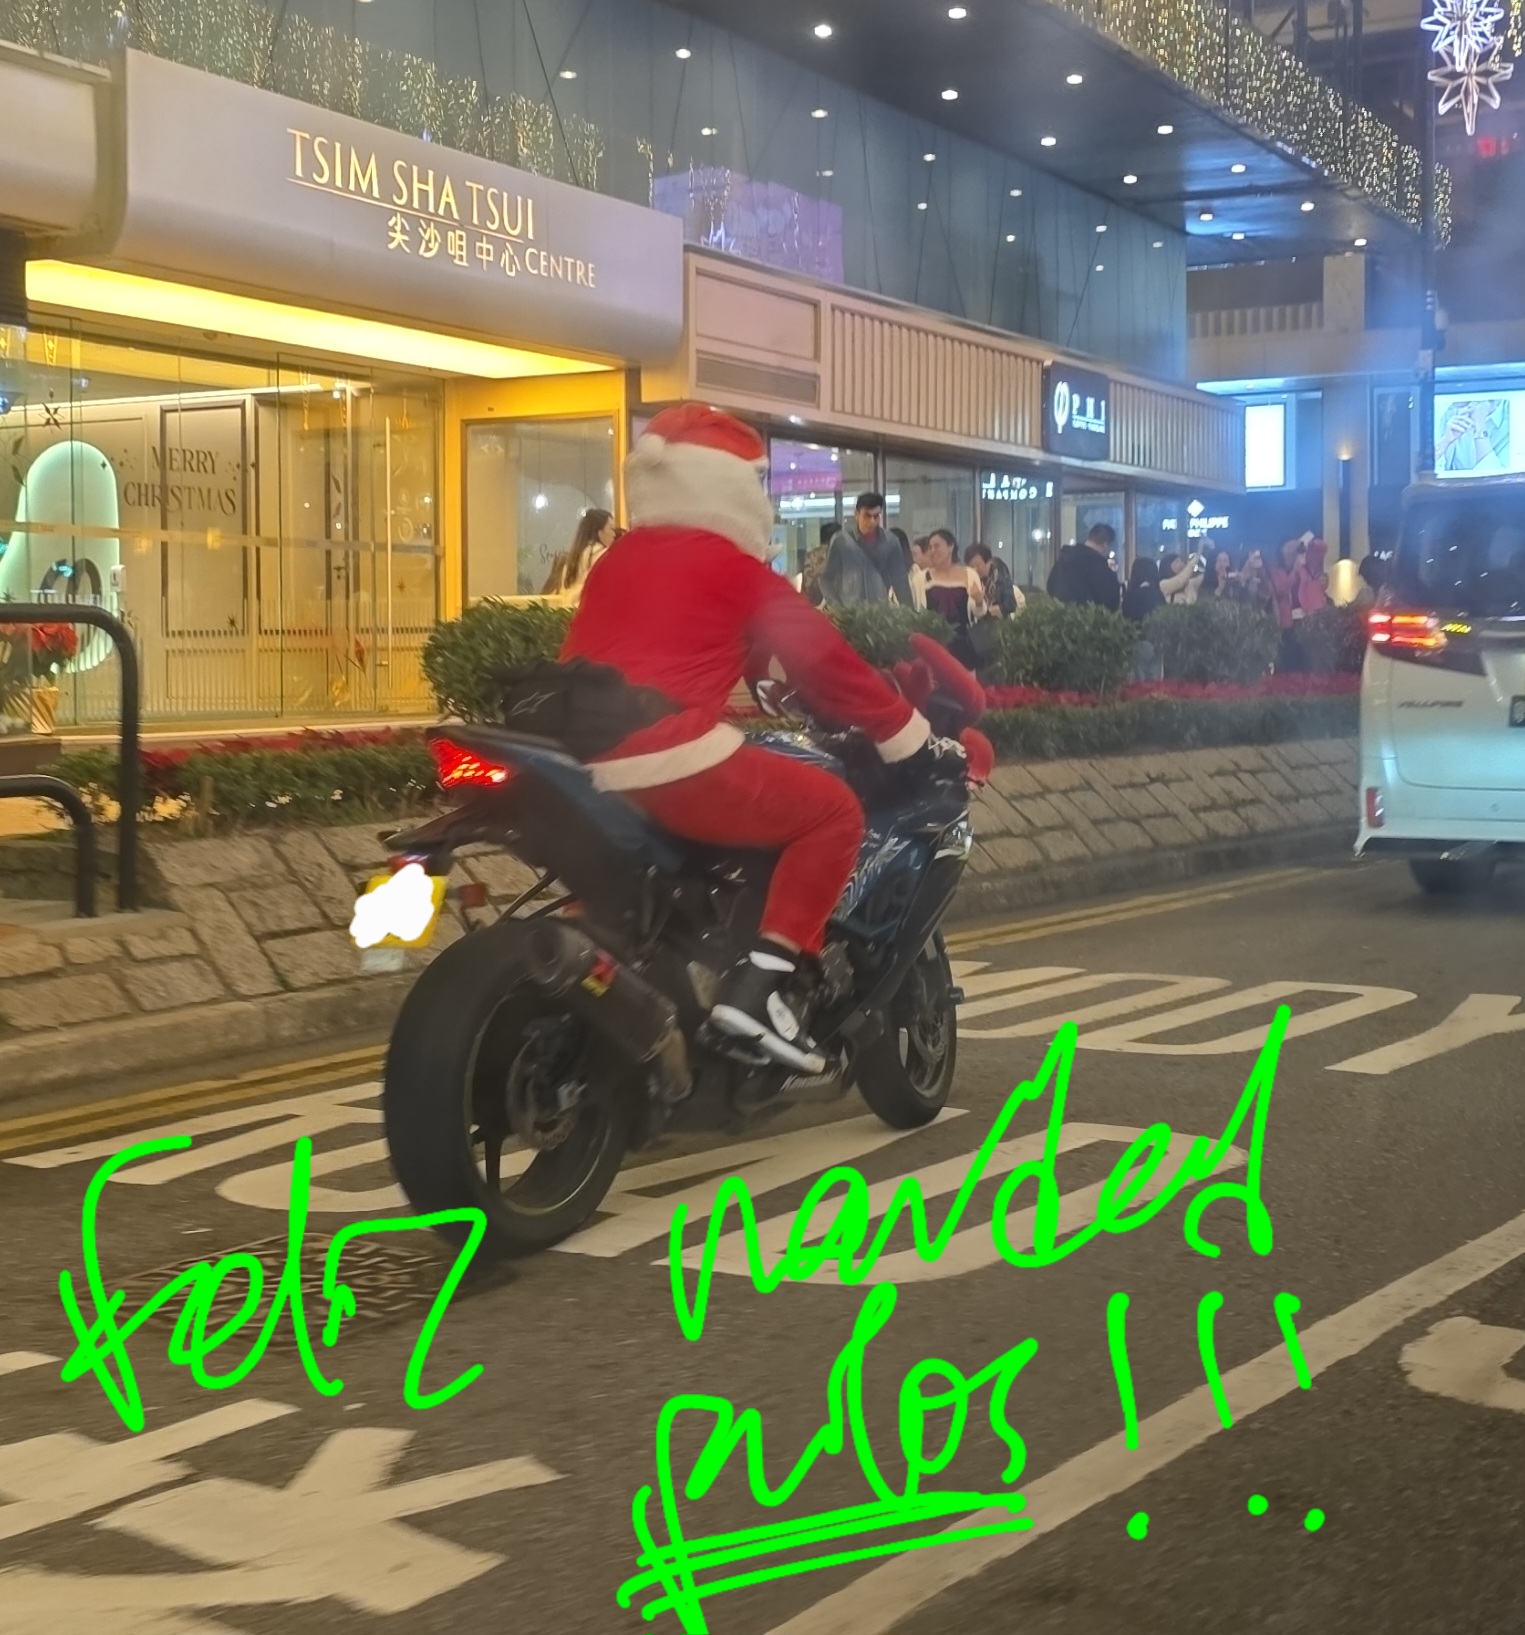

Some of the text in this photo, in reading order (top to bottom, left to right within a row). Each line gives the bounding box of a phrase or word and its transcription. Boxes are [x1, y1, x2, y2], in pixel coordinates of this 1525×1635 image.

[287, 128, 535, 240] TSIM SHA TSUI
[387, 211, 521, 278] 尖沙咀中心
[525, 248, 597, 289] CENTRE
